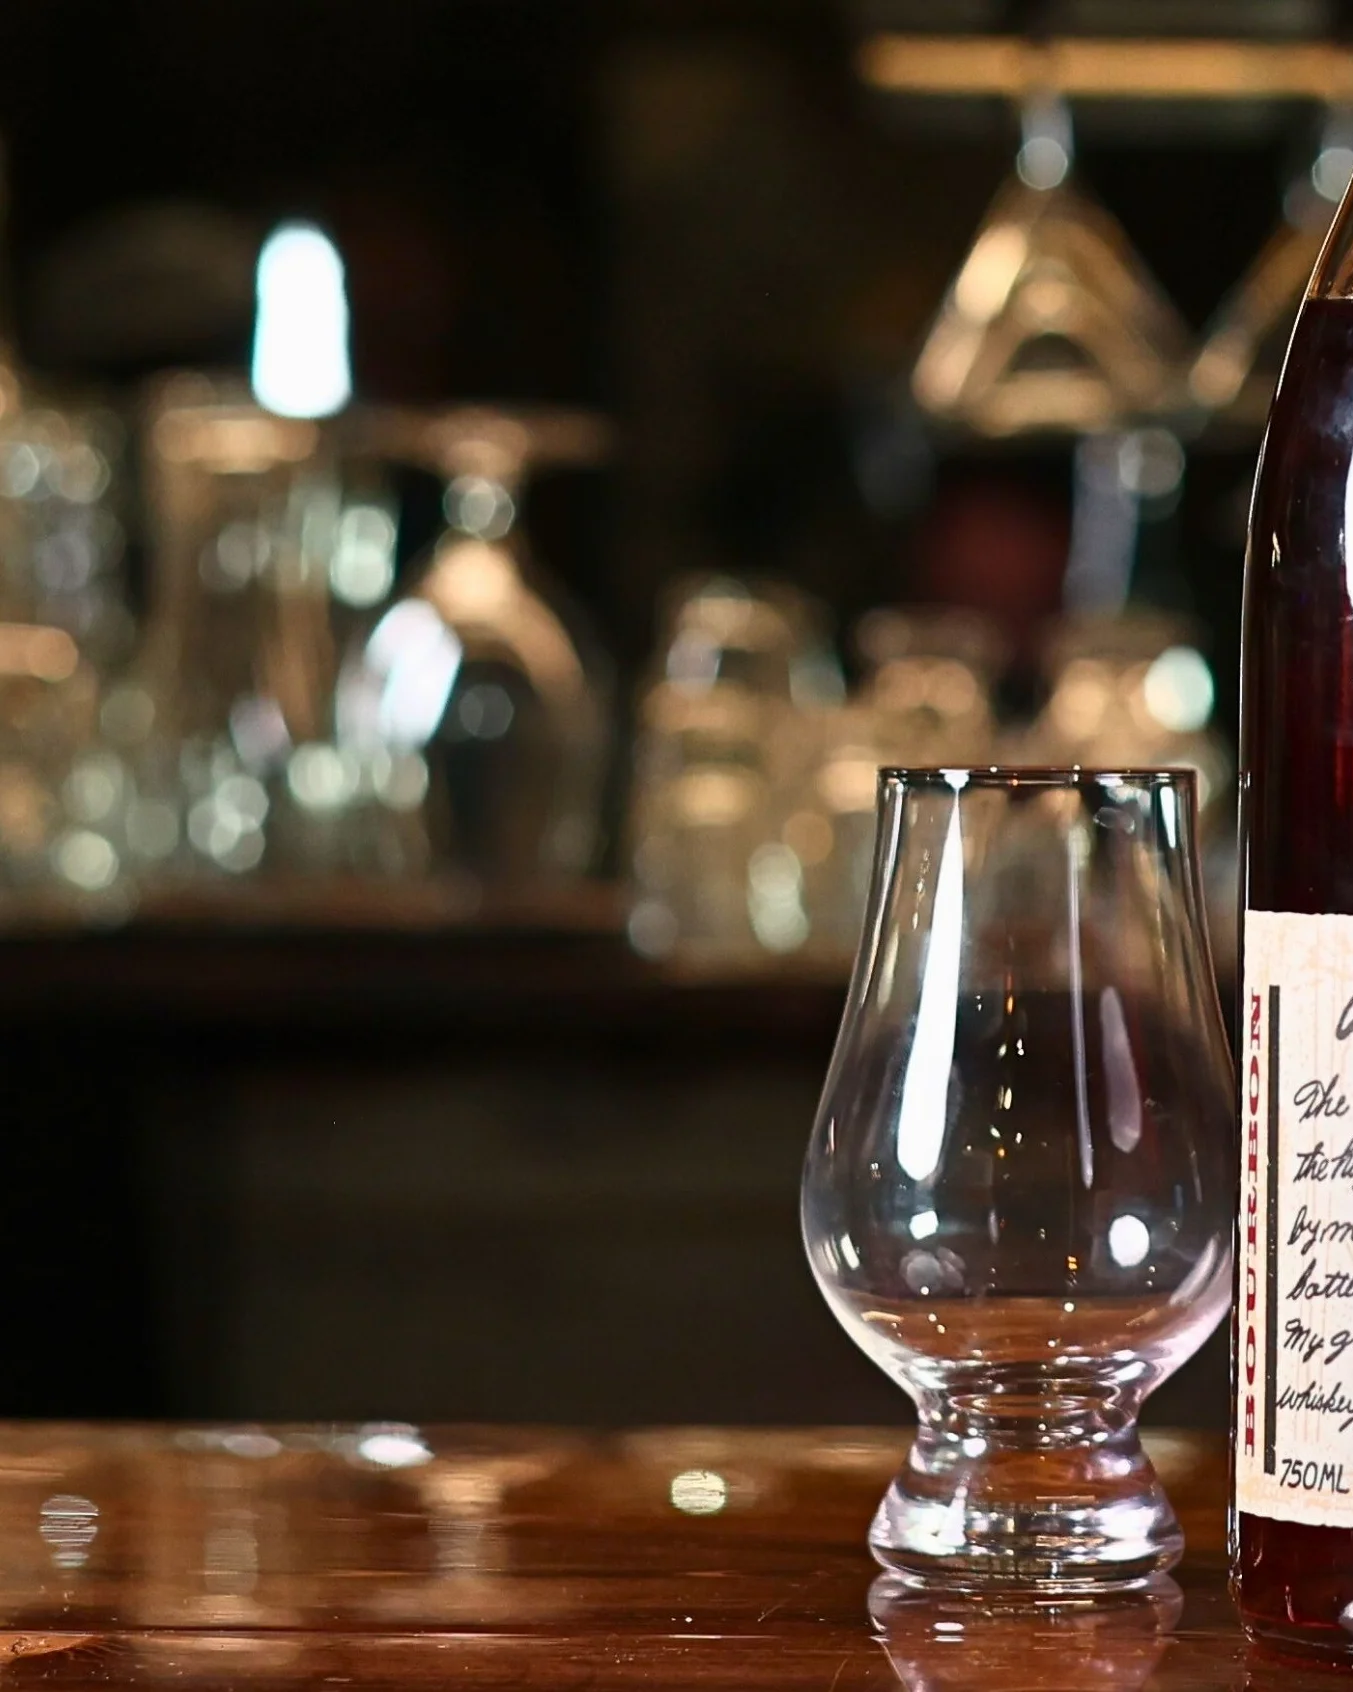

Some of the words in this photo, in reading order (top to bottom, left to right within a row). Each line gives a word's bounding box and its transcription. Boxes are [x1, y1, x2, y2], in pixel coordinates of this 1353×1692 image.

[1294, 1073, 1350, 1123] The
[1293, 1141, 1330, 1183] the
[1244, 986, 1262, 1457] BOURBON
[1287, 1204, 1321, 1256] by
[1283, 1318, 1324, 1363] My
[1279, 1458, 1351, 1495] 750ML
